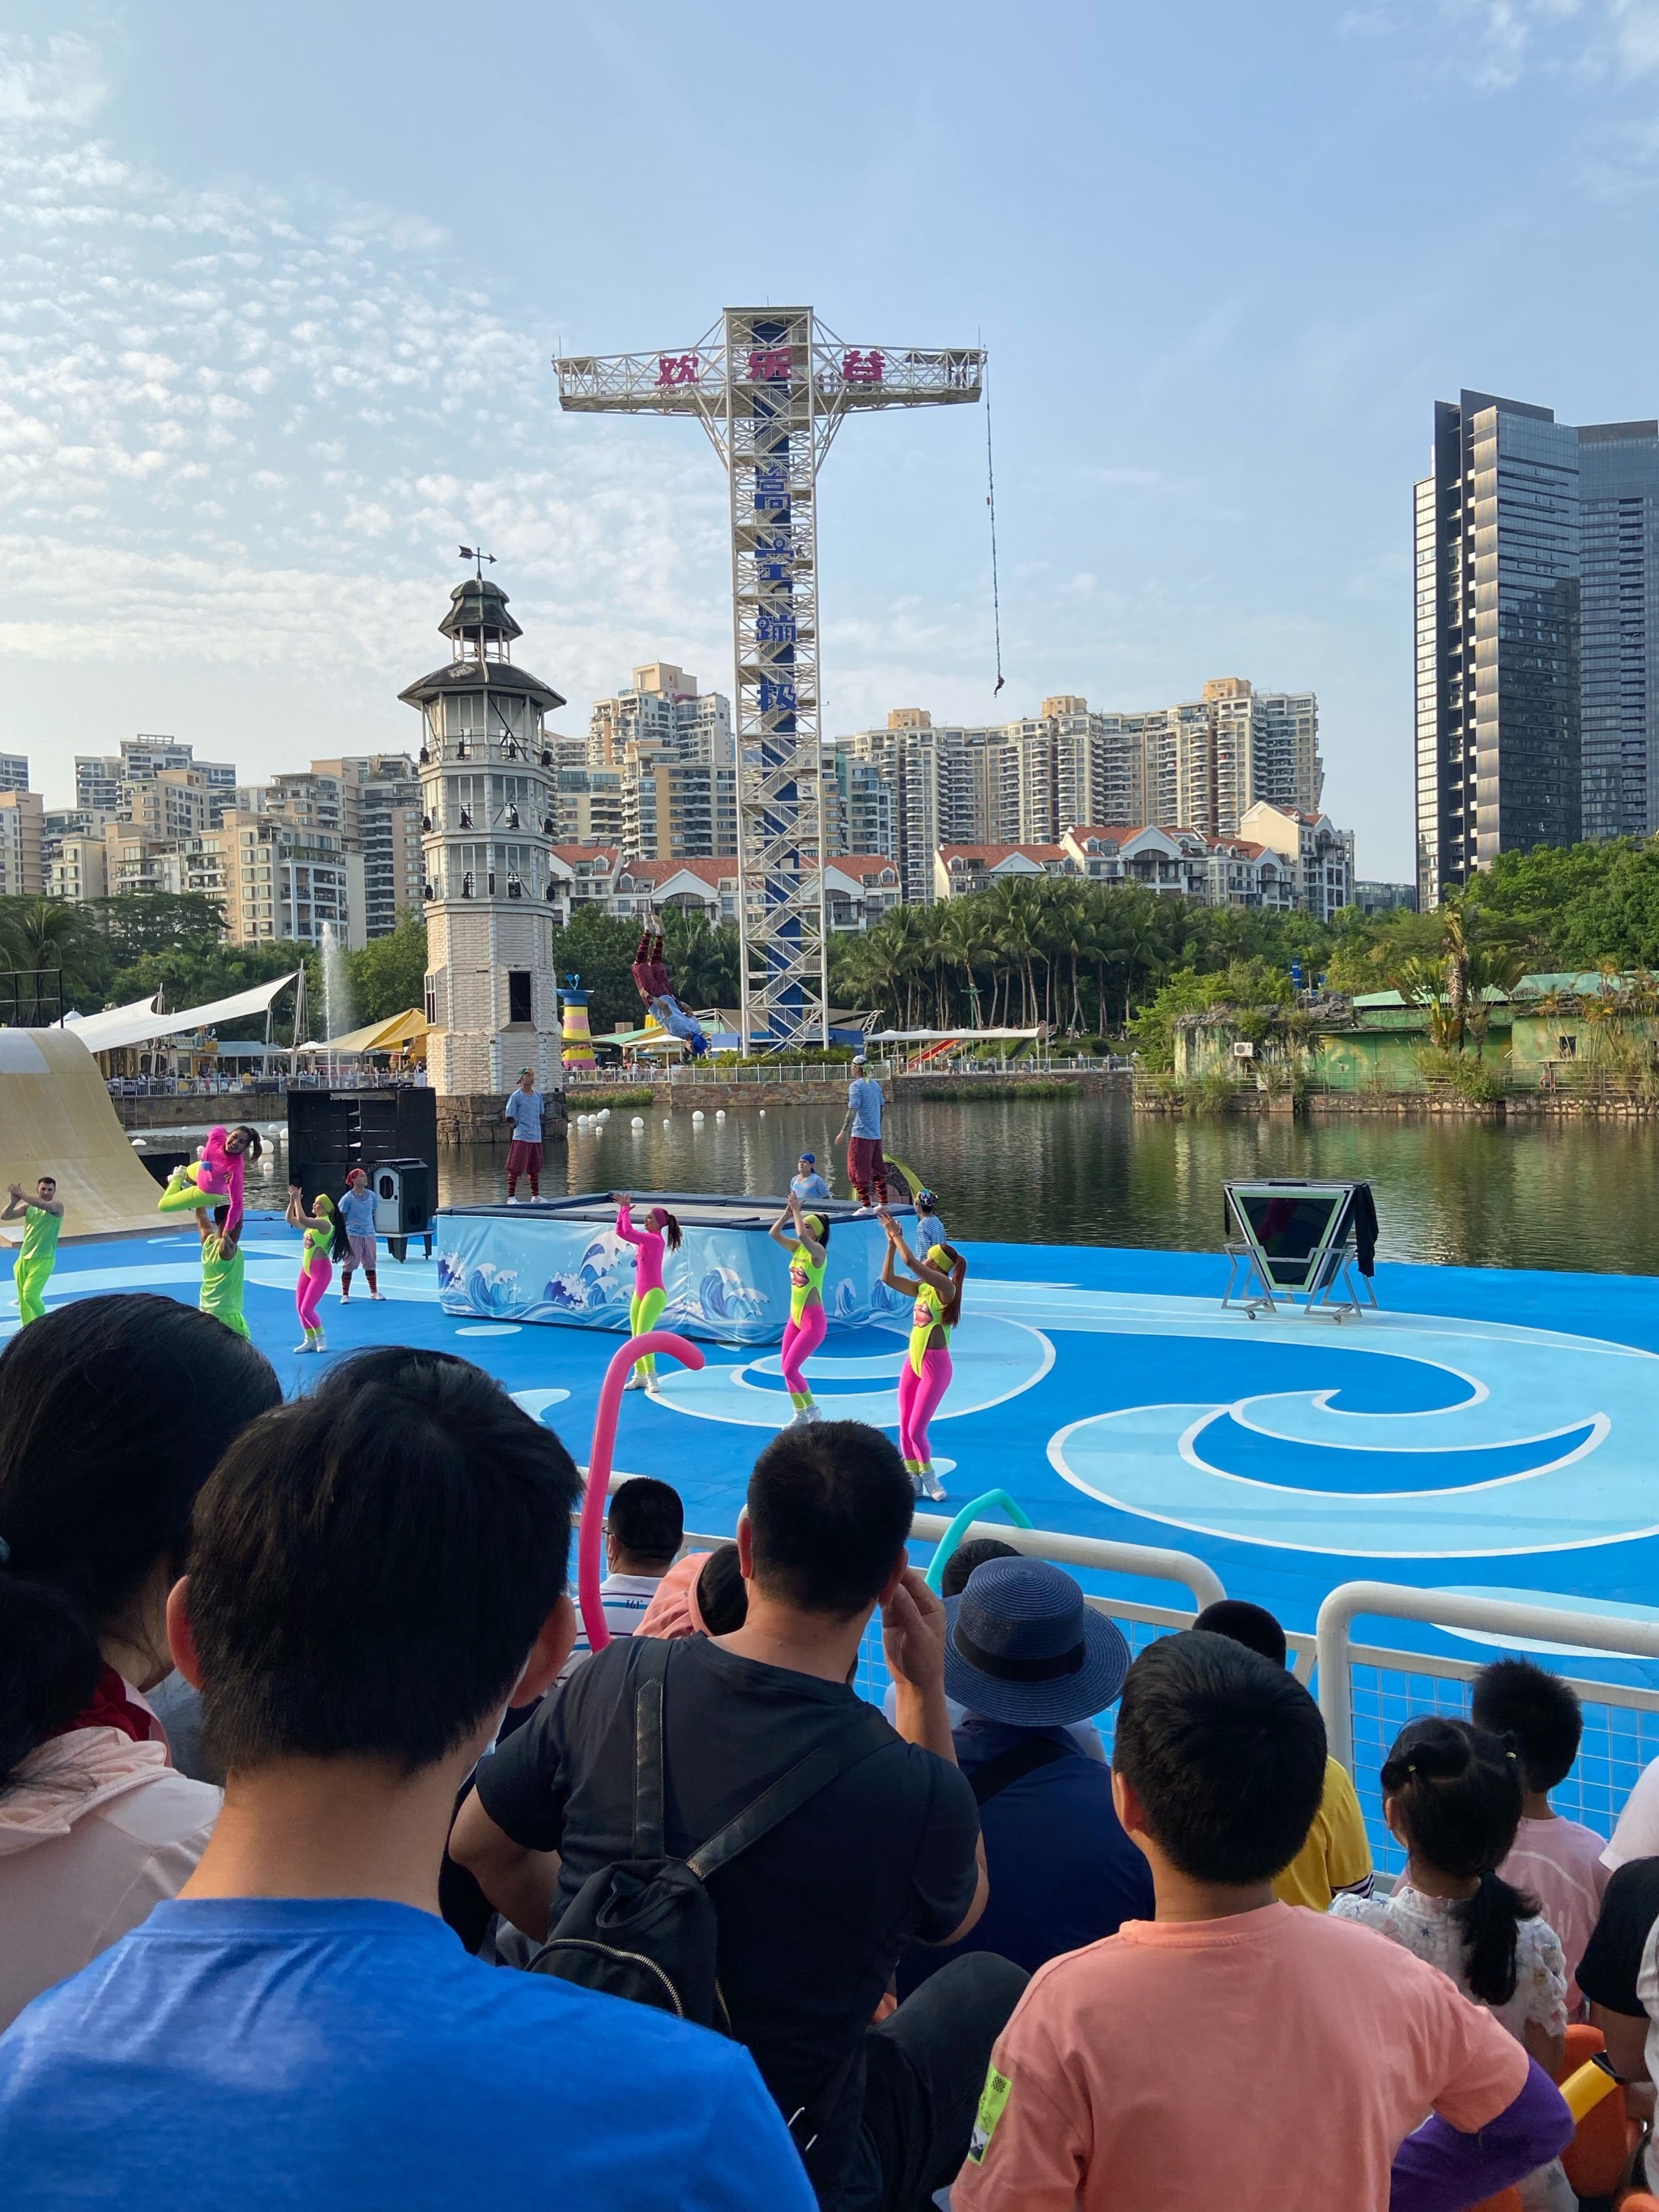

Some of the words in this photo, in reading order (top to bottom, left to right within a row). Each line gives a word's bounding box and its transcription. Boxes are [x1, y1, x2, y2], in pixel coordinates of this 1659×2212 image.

[655, 347, 886, 385] 欢乐谷
[754, 466, 797, 712] 高空蹦极
